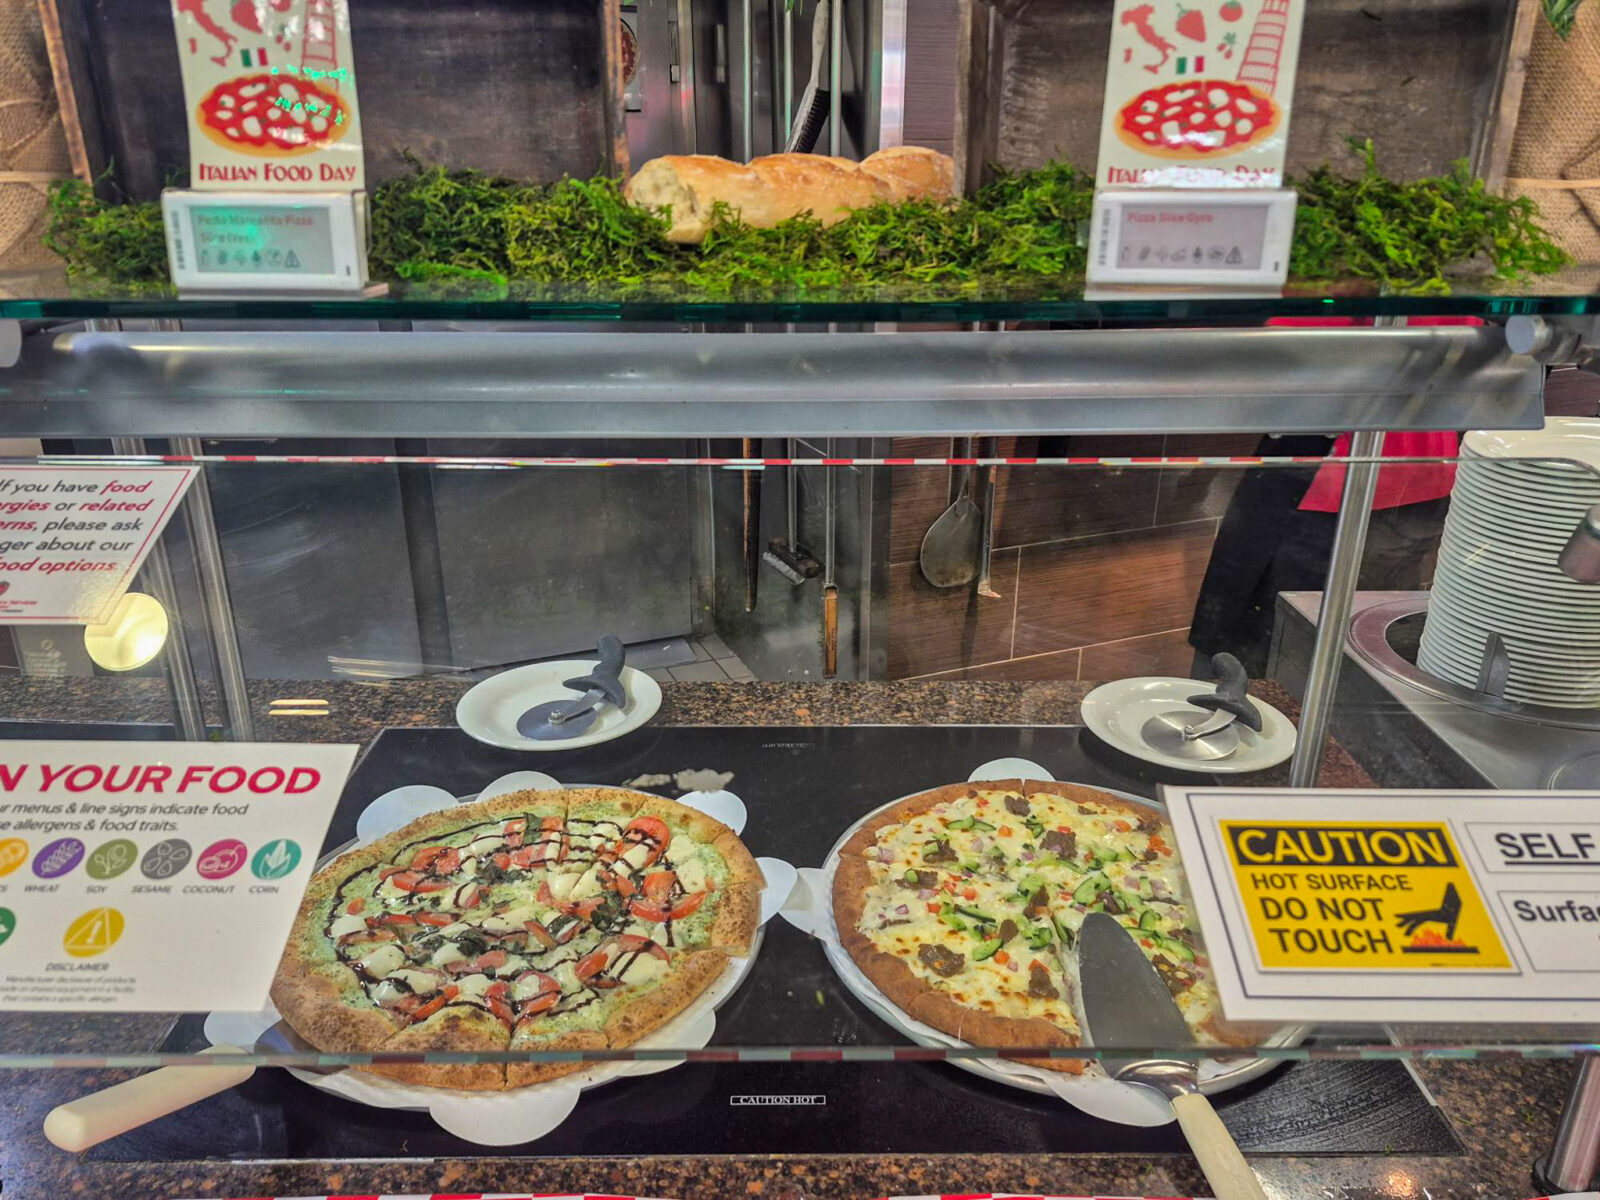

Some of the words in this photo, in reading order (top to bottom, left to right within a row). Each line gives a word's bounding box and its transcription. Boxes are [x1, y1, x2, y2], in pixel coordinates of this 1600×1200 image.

[199, 163, 258, 181] ITALIAN
[264, 163, 312, 181] FOOD
[319, 163, 356, 181] DAY
[10, 483, 48, 495] you
[53, 479, 98, 492] have
[99, 480, 153, 495] food
[54, 503, 77, 511] or
[78, 499, 154, 511] related
[42, 517, 107, 534] please
[111, 517, 144, 531] ask
[36, 537, 95, 550] about
[99, 542, 134, 551] our
[38, 558, 118, 575] options.
[38, 764, 172, 793] YOUR
[176, 765, 321, 794] FOOD
[12, 803, 63, 814] menus
[65, 802, 77, 814] &
[80, 803, 106, 814] line
[109, 803, 147, 817] signs
[149, 803, 208, 815] indicate
[211, 803, 249, 815] food
[13, 819, 81, 833] allergens
[83, 819, 95, 831] &
[100, 818, 137, 831] food
[139, 819, 178, 831] traits.
[1237, 829, 1448, 865] CAUTION
[1494, 832, 1597, 860] SELF
[24, 884, 60, 893] WHEAT
[86, 885, 108, 894] SOY
[131, 885, 173, 894] SESAME
[182, 885, 236, 894] COCONUT
[249, 885, 279, 894] CORN
[1252, 874, 1298, 891] HOT
[1306, 874, 1413, 892] SURFACE
[1259, 897, 1308, 921] DO
[1319, 897, 1384, 922] NOT
[1513, 899, 1600, 922] Surfa
[1268, 928, 1394, 954] TOUCH
[45, 962, 110, 972] DISCLAIMER
[739, 1096, 790, 1104] CAUTION
[793, 1096, 816, 1104] HOT
